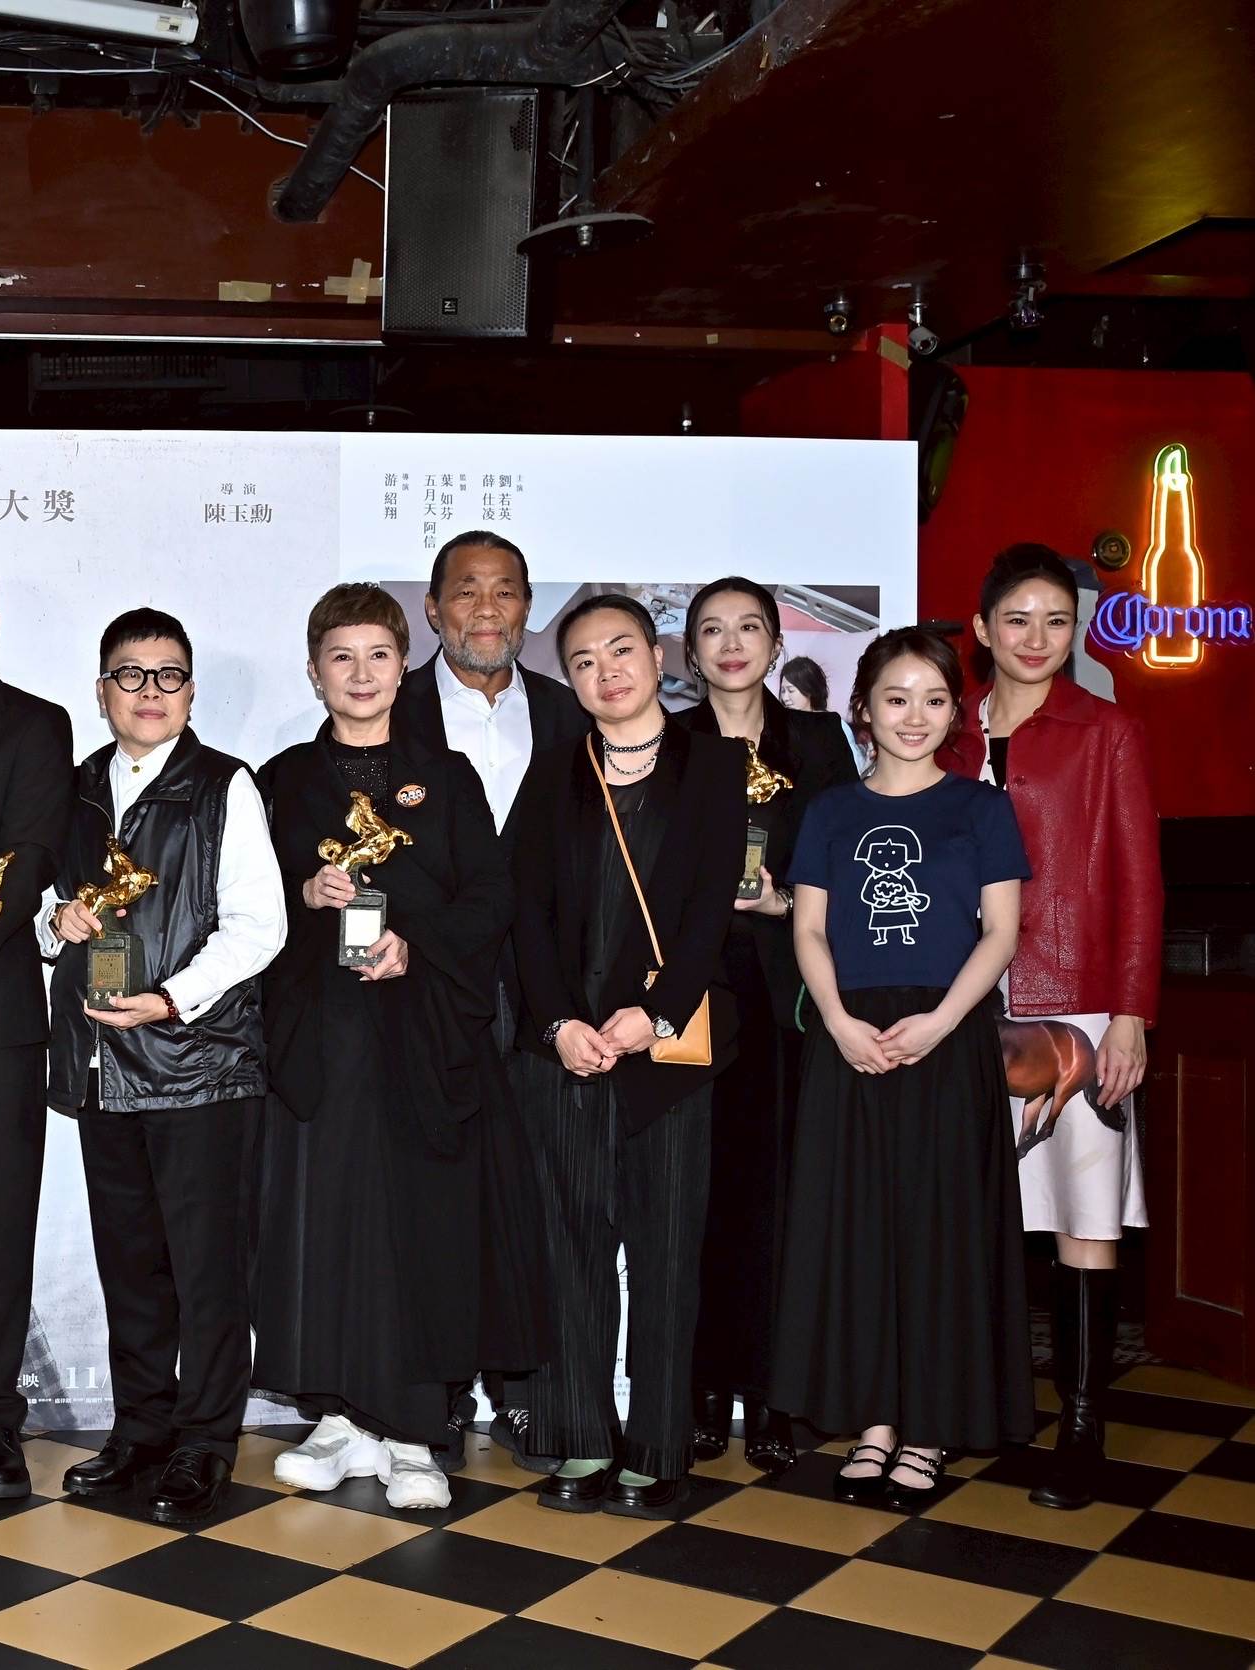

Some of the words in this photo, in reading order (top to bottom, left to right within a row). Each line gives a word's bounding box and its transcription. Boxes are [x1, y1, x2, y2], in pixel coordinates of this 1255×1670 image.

[220, 482, 257, 495] 導演
[384, 472, 398, 520] 游紹翔
[424, 474, 438, 517] 五月天
[440, 473, 454, 521] 葉如芬
[482, 474, 495, 521] 薛仕凌
[498, 474, 512, 521] 劉若英
[204, 503, 272, 523] 陳玉勳
[423, 521, 436, 549] 阿信
[1096, 591, 1250, 651] Corona
